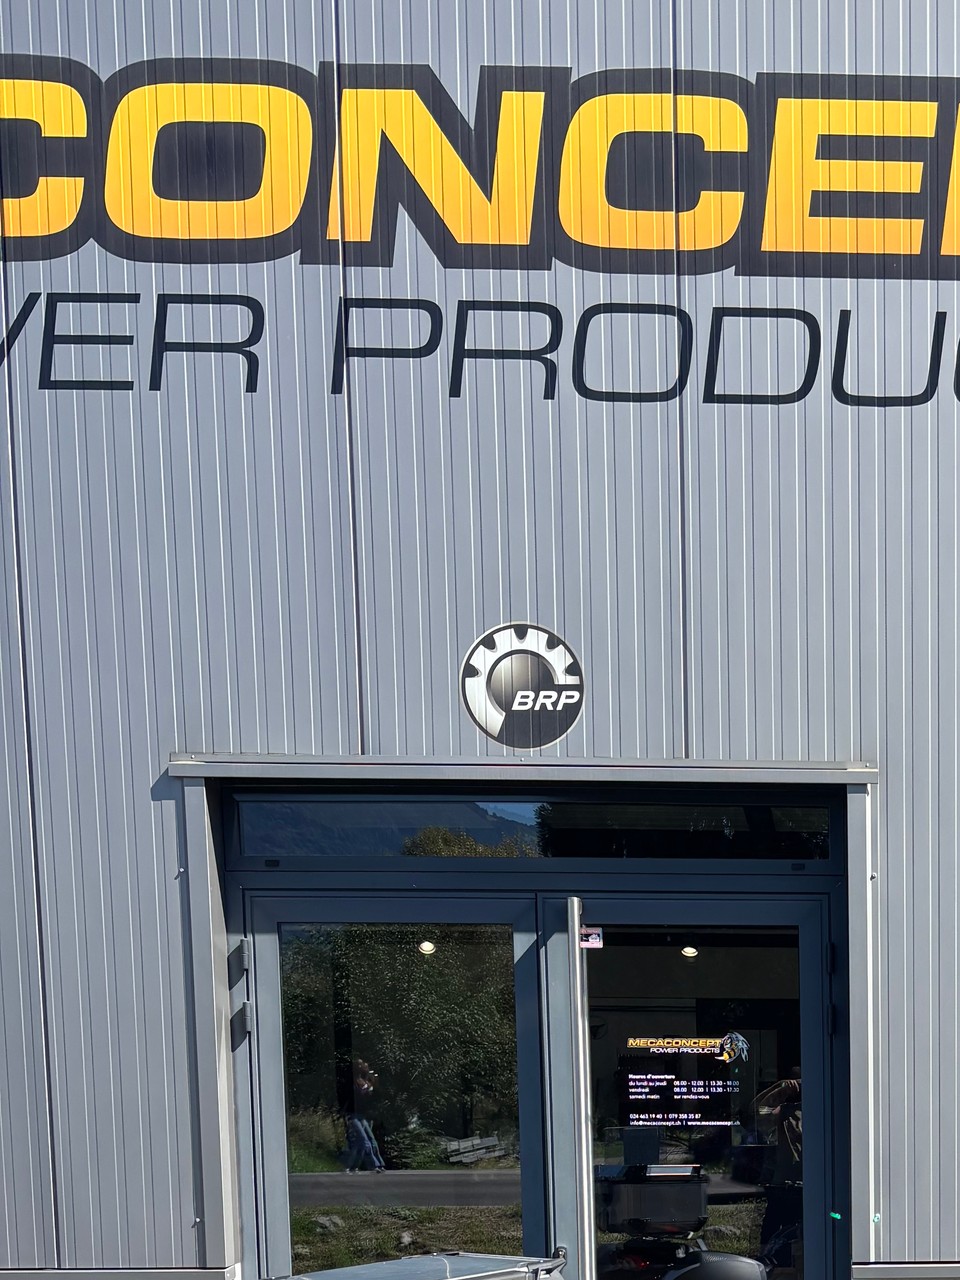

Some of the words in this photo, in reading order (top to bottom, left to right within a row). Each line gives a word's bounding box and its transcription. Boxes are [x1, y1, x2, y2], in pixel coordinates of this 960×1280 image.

[0, 292, 266, 394] ER
[511, 690, 580, 711] BRP
[627, 1037, 722, 1048] MECACONCEPT
